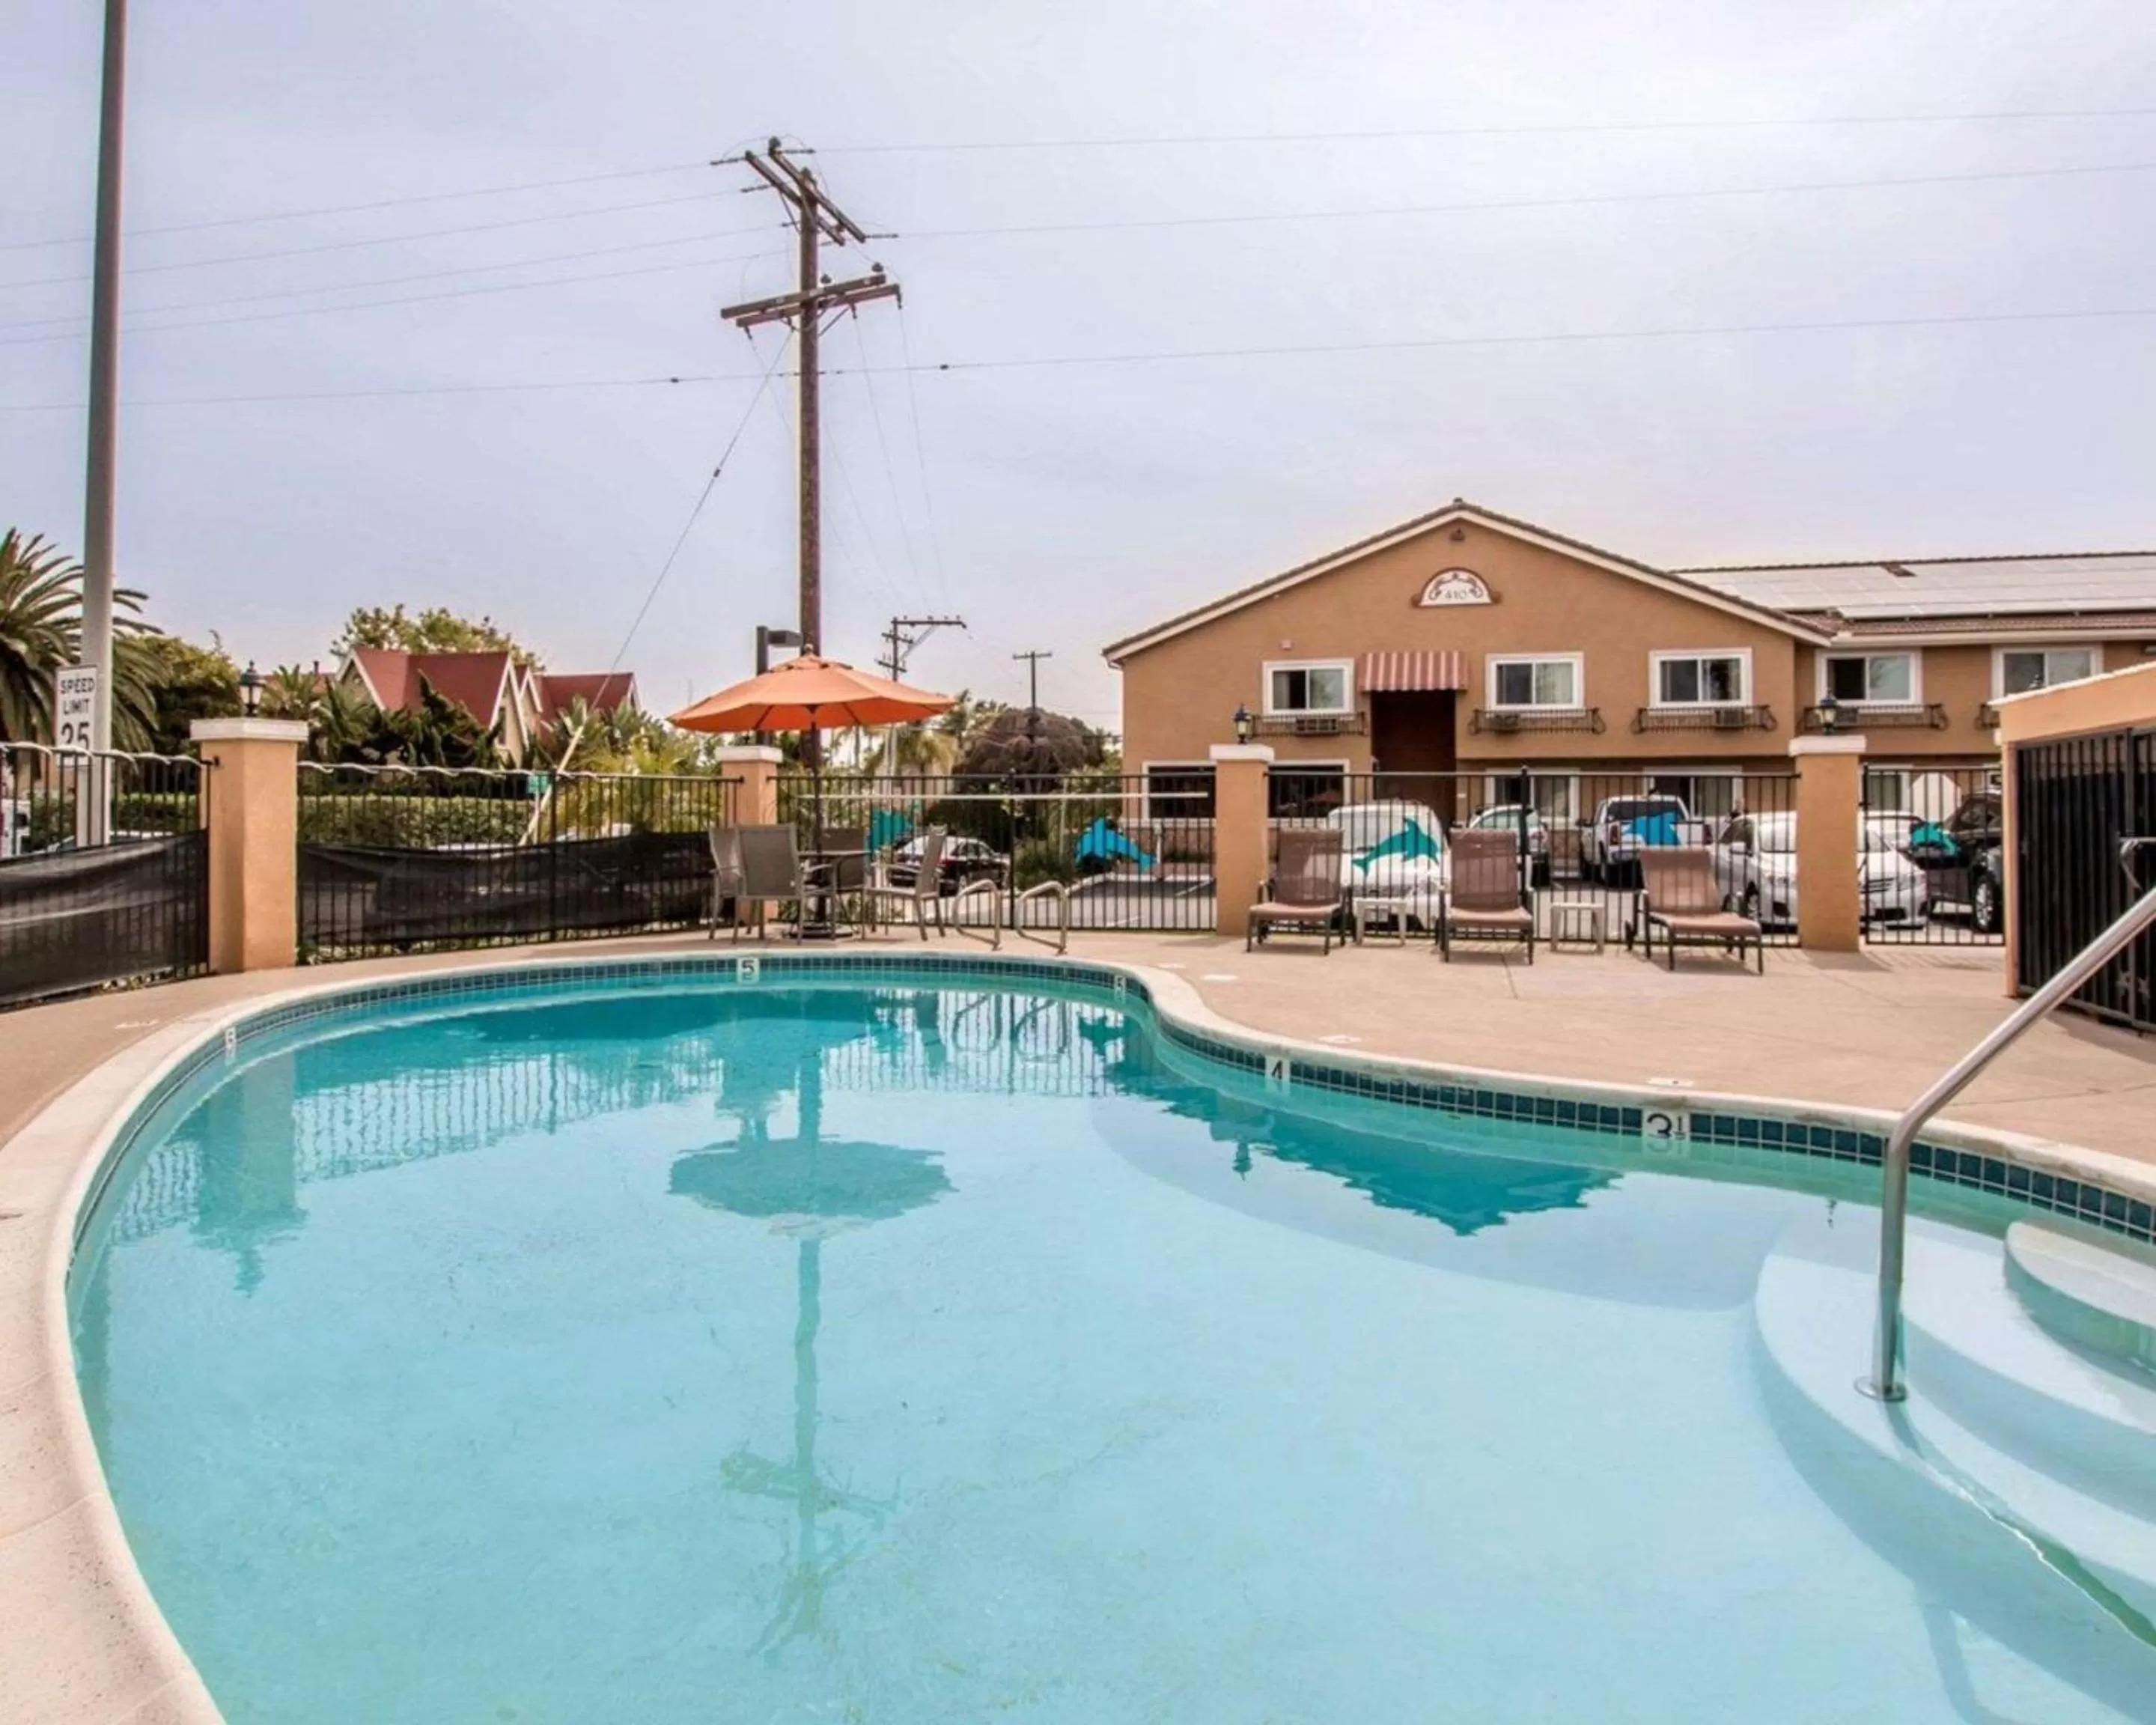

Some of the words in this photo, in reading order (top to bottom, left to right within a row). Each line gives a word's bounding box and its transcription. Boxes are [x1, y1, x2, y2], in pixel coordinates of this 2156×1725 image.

[61, 677, 94, 693] SPEED
[64, 698, 89, 714] LIMIT
[61, 722, 89, 749] 25
[742, 959, 755, 974] 5
